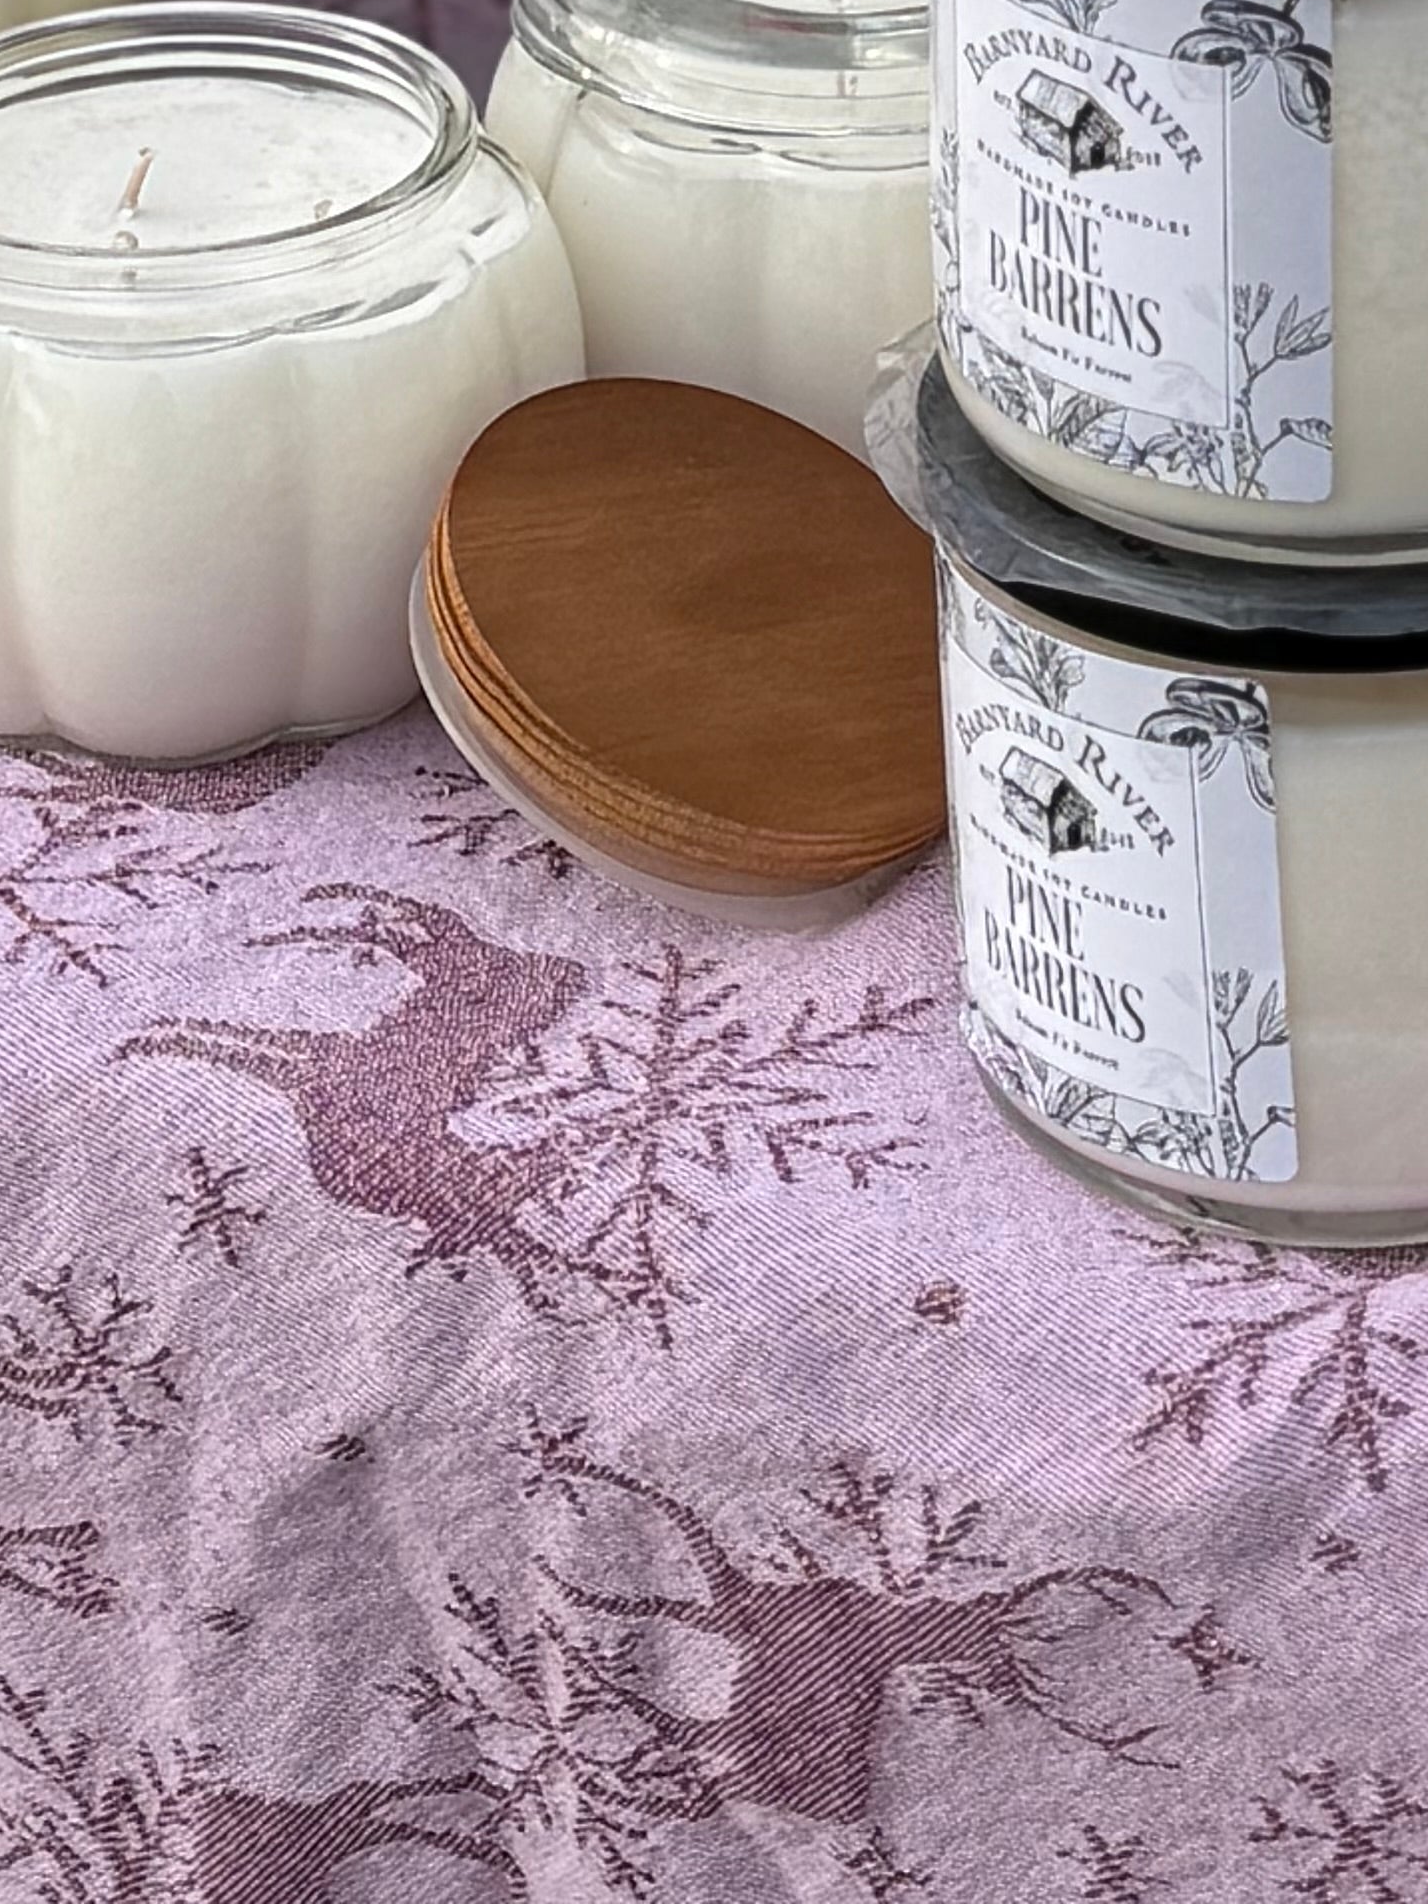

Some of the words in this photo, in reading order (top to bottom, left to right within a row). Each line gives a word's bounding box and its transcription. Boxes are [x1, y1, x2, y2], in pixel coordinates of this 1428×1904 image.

[1103, 55, 1203, 174] RIVER
[1021, 186, 1103, 278] PINE
[990, 229, 1162, 358] BARRENS
[1076, 734, 1175, 858] RIVER
[1007, 865, 1085, 961] PINE
[985, 906, 1146, 1043] BARRENS
